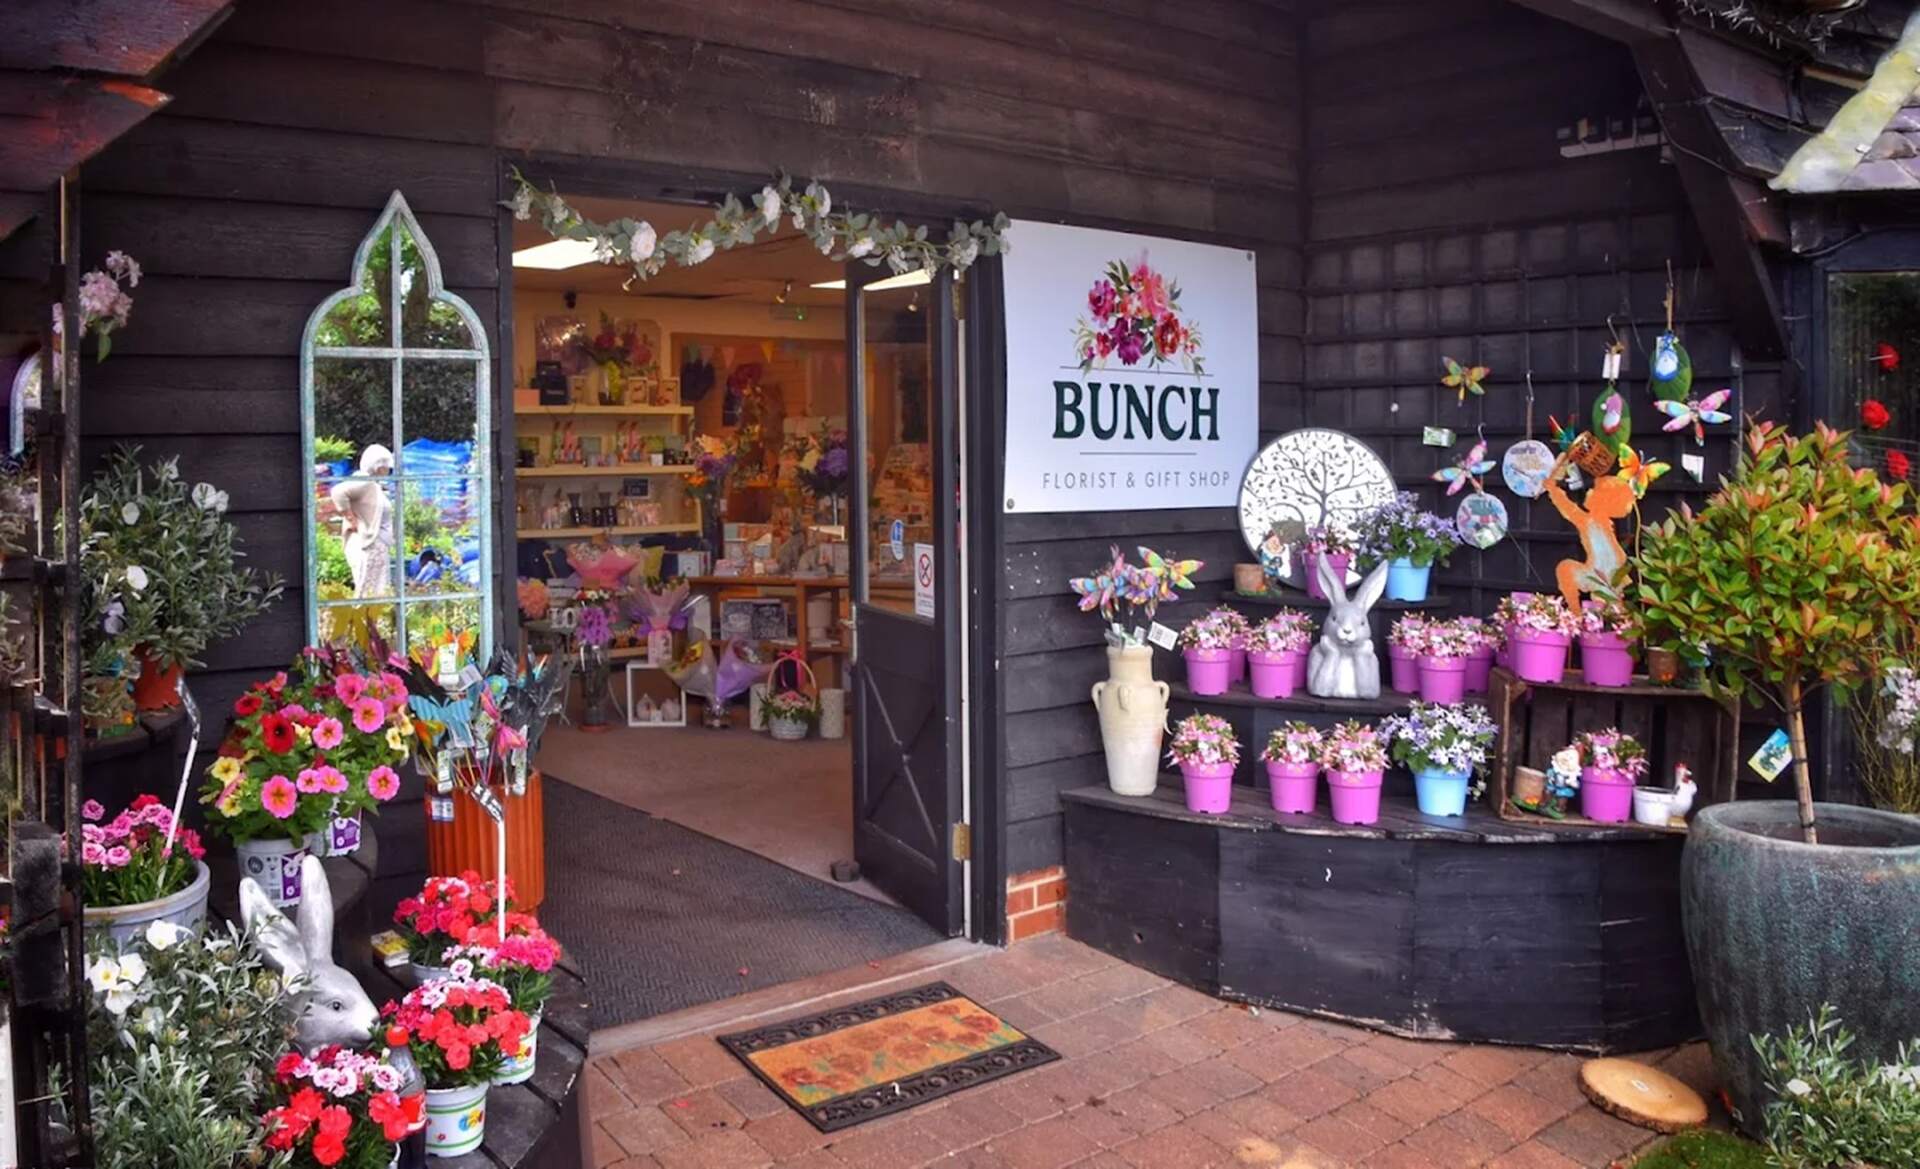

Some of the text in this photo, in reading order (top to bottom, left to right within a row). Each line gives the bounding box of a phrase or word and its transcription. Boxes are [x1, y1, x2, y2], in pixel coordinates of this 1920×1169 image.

[1052, 380, 1220, 441] BUNCH
[1042, 471, 1231, 489] FLORIST & GIFT SHOP
